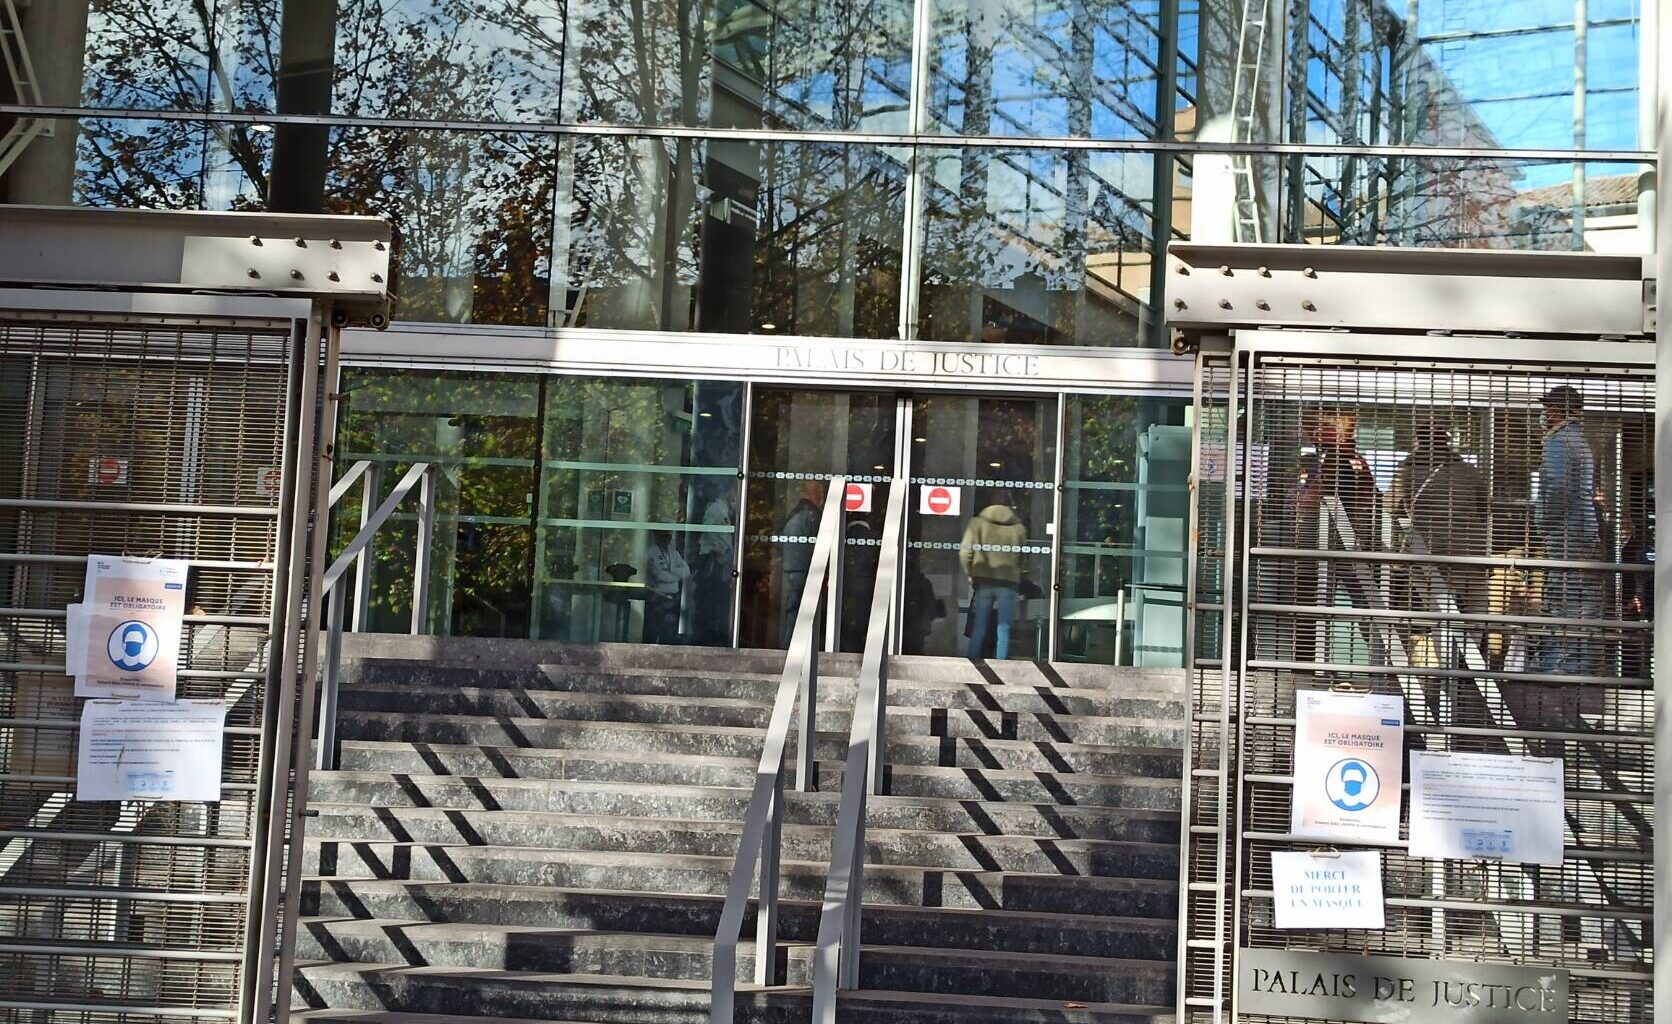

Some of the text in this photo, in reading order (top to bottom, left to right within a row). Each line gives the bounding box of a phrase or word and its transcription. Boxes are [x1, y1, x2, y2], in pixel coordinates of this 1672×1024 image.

[776, 347, 1039, 376] PALAIS DE JUSTICE
[1338, 739, 1384, 748] OBLIGATOIRE
[1304, 870, 1345, 880] MERCI
[1311, 884, 1361, 894] PORTER
[1252, 968, 1556, 1013] PALAIS DE JUSTICE
